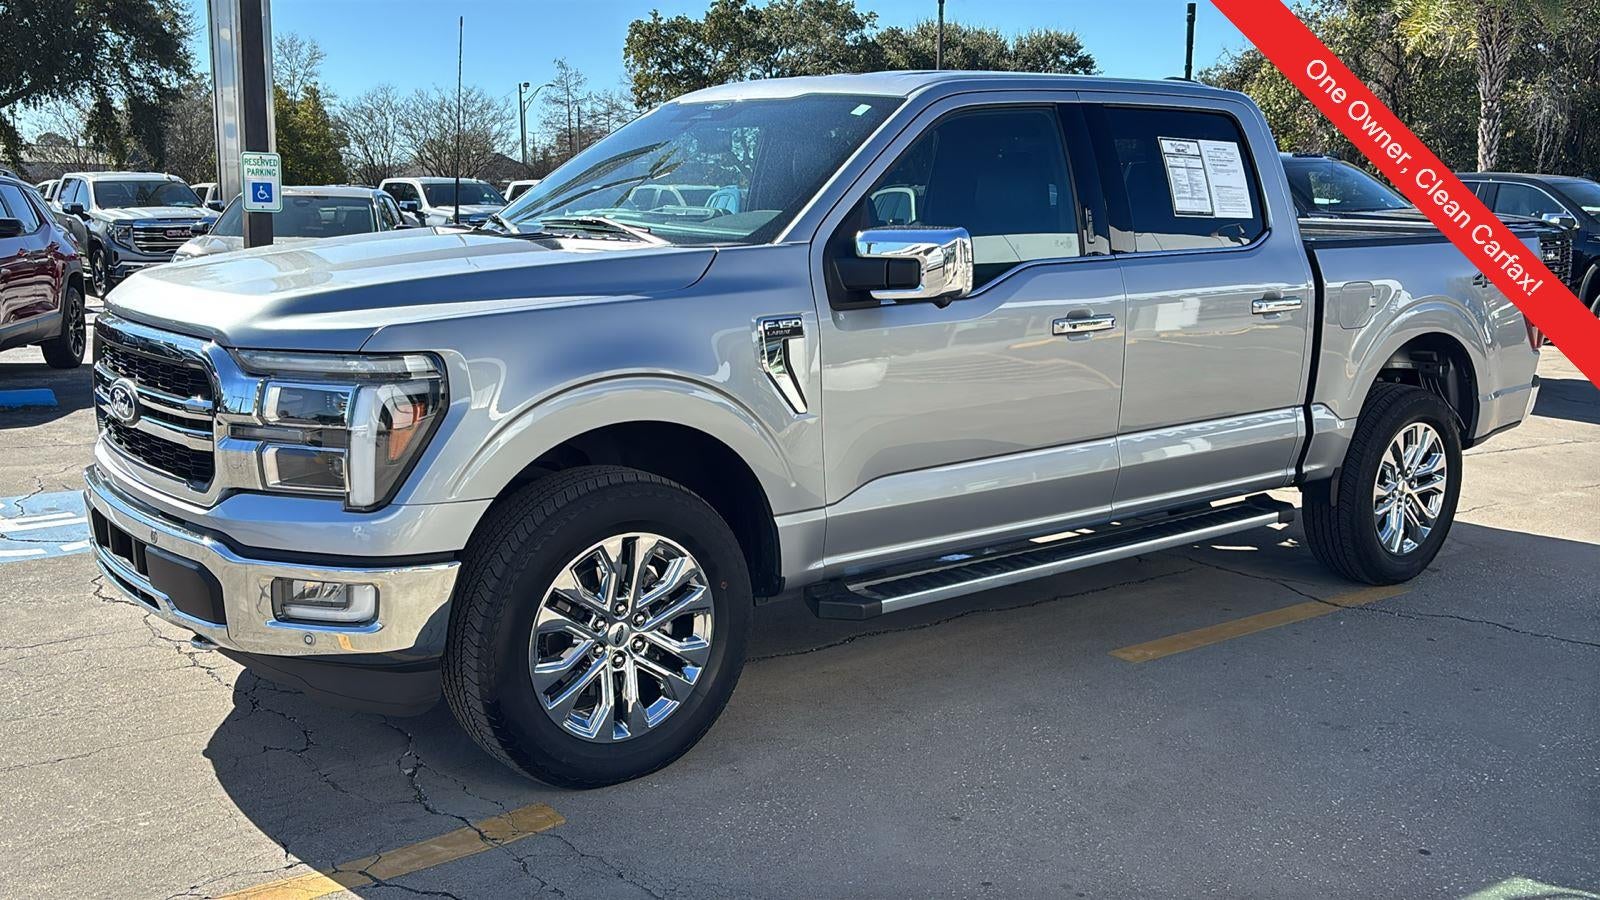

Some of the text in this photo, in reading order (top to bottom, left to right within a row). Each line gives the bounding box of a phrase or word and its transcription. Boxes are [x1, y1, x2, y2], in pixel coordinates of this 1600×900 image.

[244, 158, 278, 167] RESERVED
[247, 168, 277, 177] PARKING
[166, 229, 191, 237] GM
[764, 319, 802, 330] F-150
[112, 388, 130, 416] Ford
